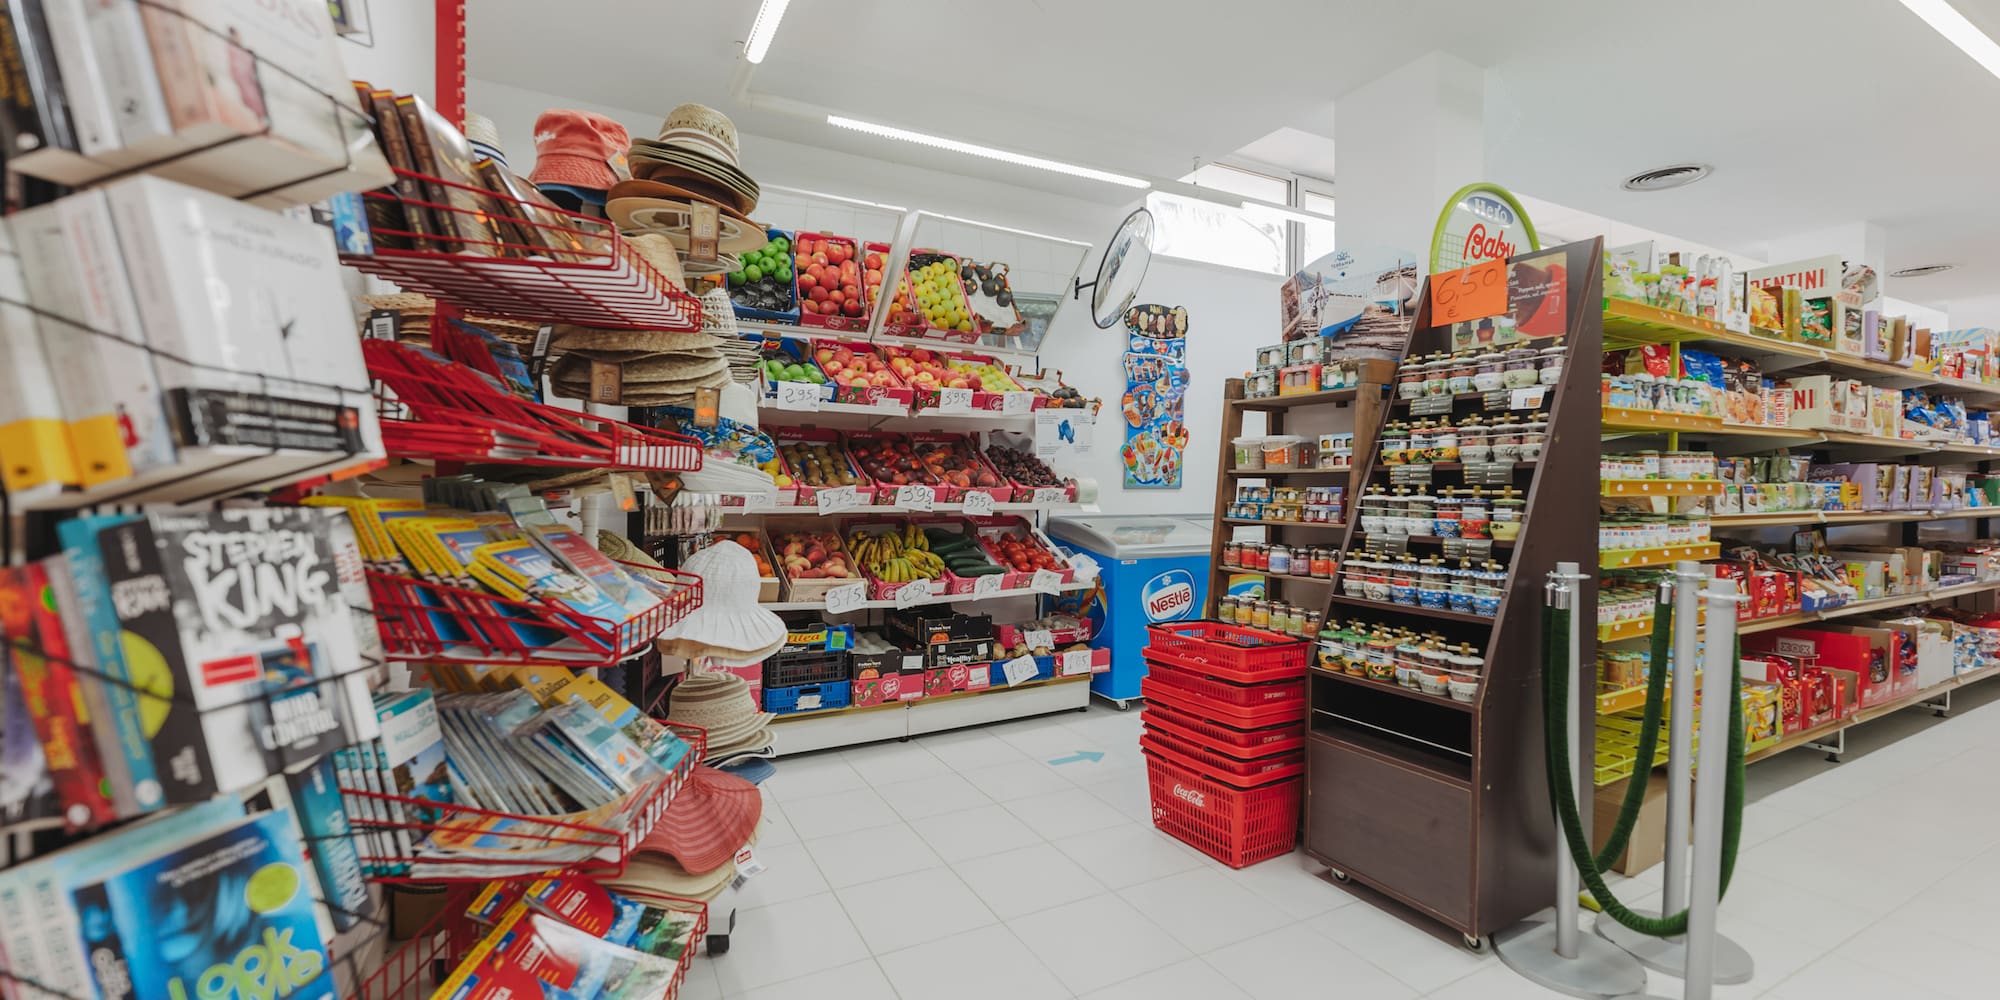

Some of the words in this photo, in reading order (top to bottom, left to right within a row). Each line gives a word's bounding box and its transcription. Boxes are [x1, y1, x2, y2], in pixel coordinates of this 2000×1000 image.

[1474, 198, 1508, 221] Hero
[1463, 223, 1516, 260] Baby
[182, 529, 317, 571] STEPHEN
[184, 555, 331, 632] KING
